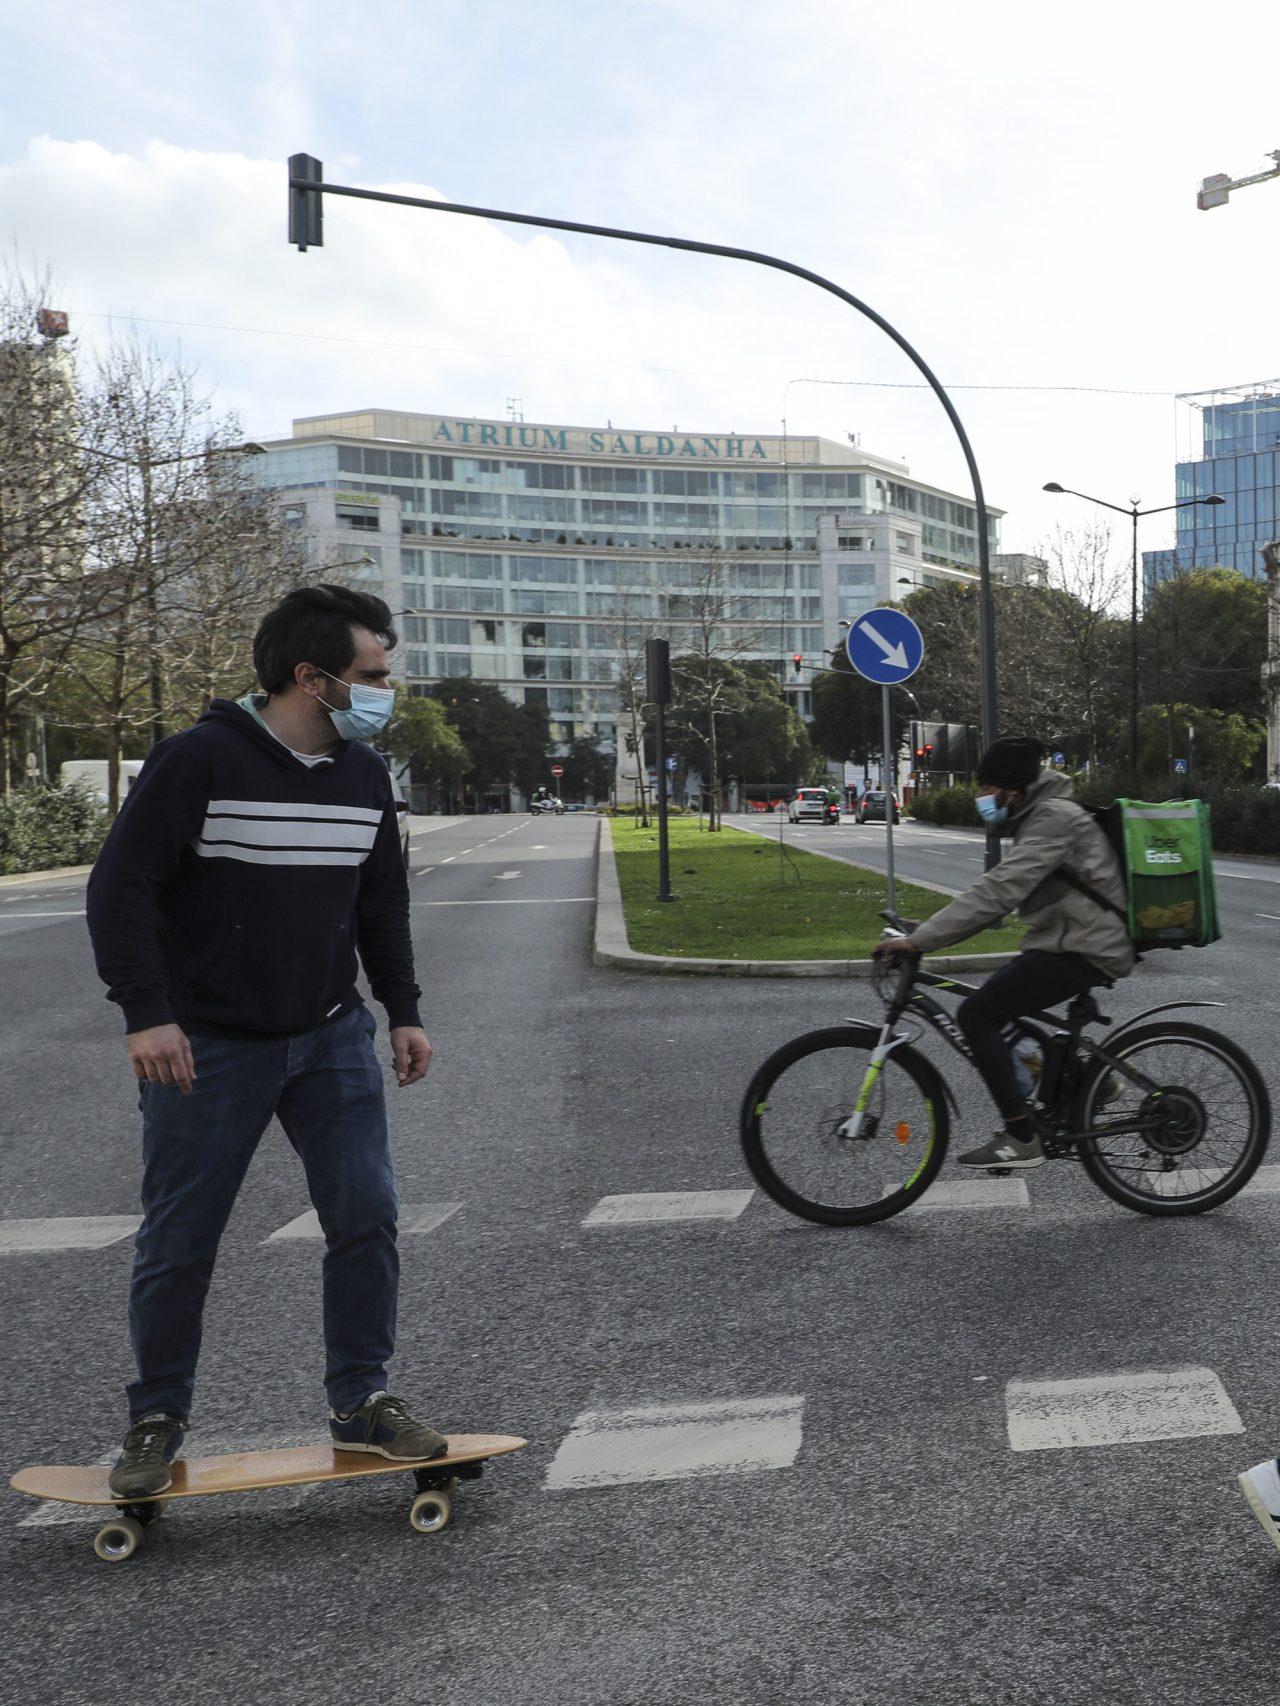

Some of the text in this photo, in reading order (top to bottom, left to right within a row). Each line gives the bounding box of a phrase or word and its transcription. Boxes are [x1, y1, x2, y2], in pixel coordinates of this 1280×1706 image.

[434, 420, 768, 459] ATRIUM SALDANHA
[1145, 835, 1180, 848] Uber
[1145, 850, 1182, 863] Eats
